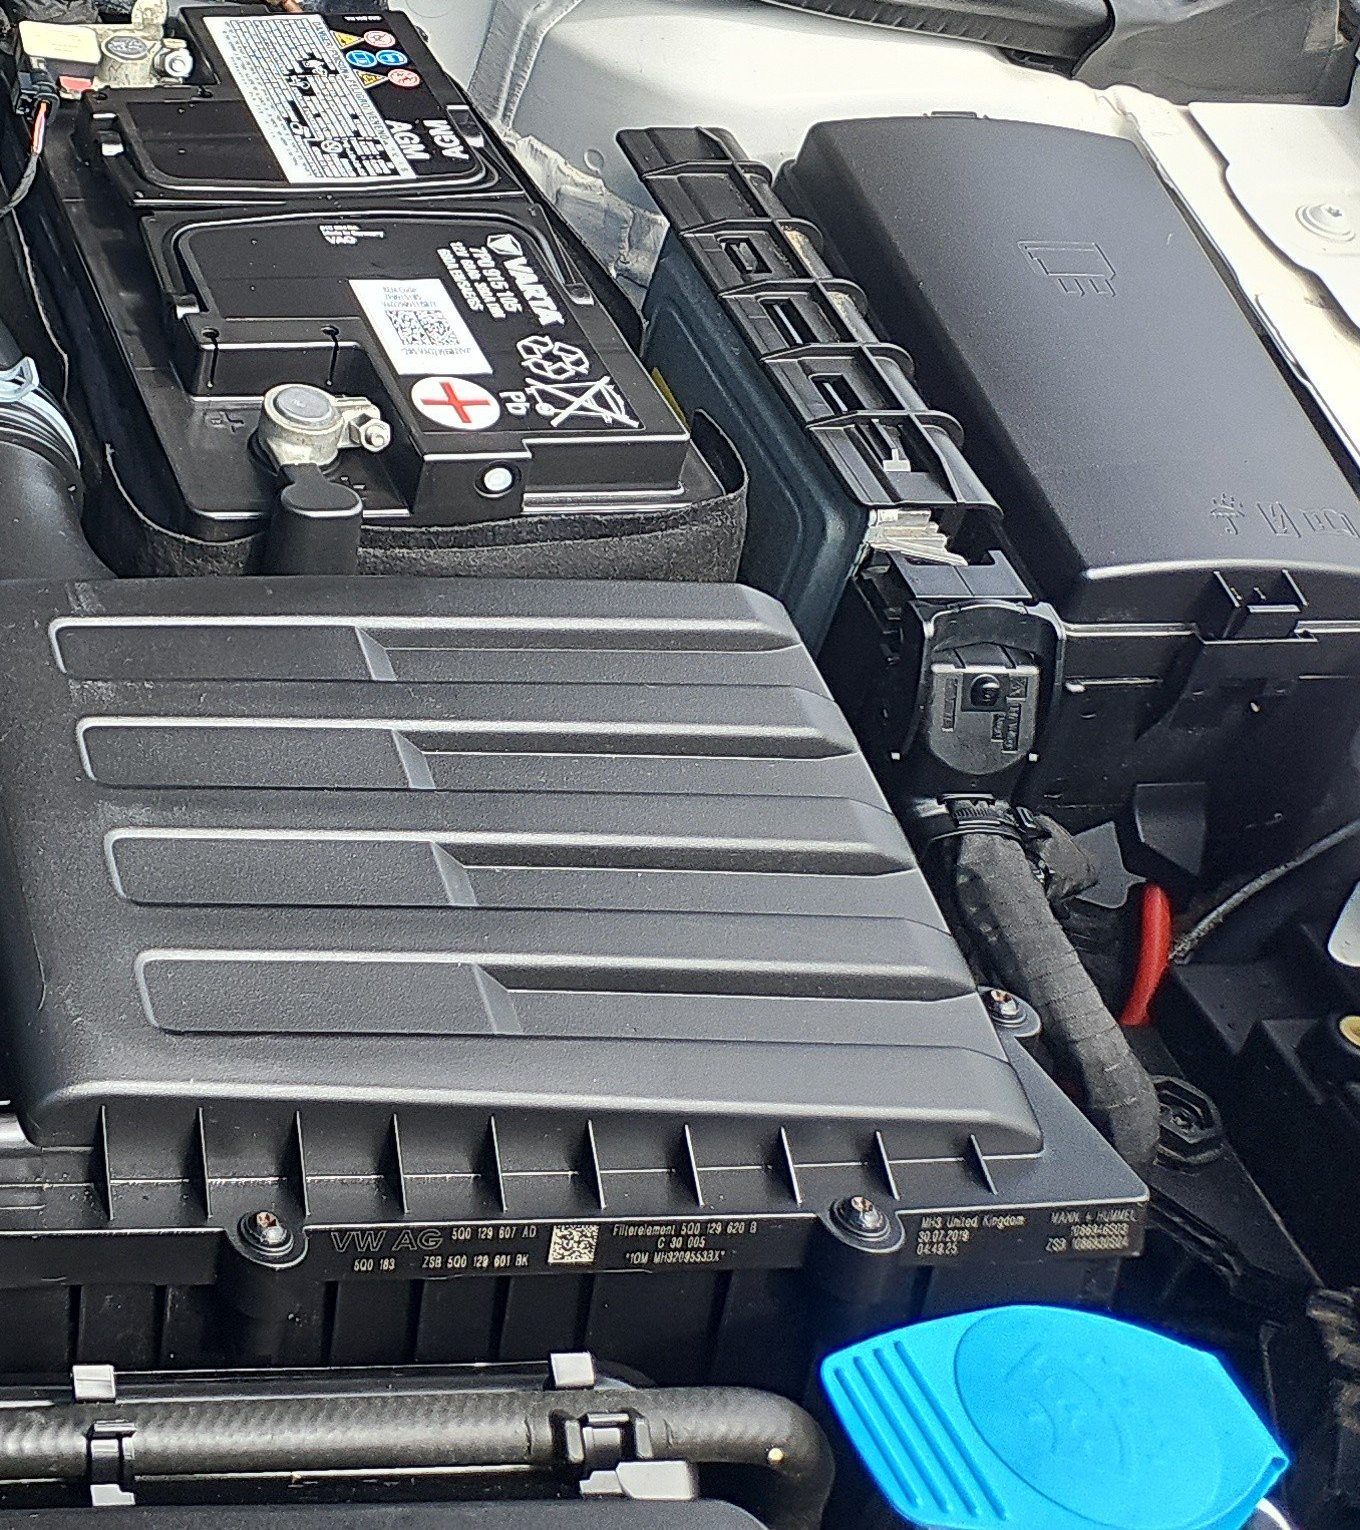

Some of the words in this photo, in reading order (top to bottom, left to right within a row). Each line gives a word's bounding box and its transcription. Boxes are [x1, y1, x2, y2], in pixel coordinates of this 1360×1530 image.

[385, 119, 430, 161] AGM
[423, 119, 470, 160] AGM
[482, 268, 509, 290] 915
[496, 290, 523, 314] 105
[503, 256, 565, 327] VARTA
[498, 390, 531, 417] Pb
[477, 1227, 493, 1240] 129
[498, 1226, 516, 1239] 607
[521, 1226, 537, 1239] AD
[706, 1223, 722, 1236] 129
[727, 1222, 745, 1235] 620
[946, 1215, 979, 1228] United
[982, 1214, 1026, 1231] Kingdom
[331, 1231, 386, 1253] VW
[392, 1228, 444, 1251] AG
[670, 1236, 683, 1249] 30
[687, 1236, 706, 1249] 005
[379, 1258, 396, 1270] 183
[421, 1256, 442, 1269] ZSB
[473, 1255, 489, 1268] 129
[493, 1254, 511, 1267] 601
[515, 1253, 530, 1267] BK
